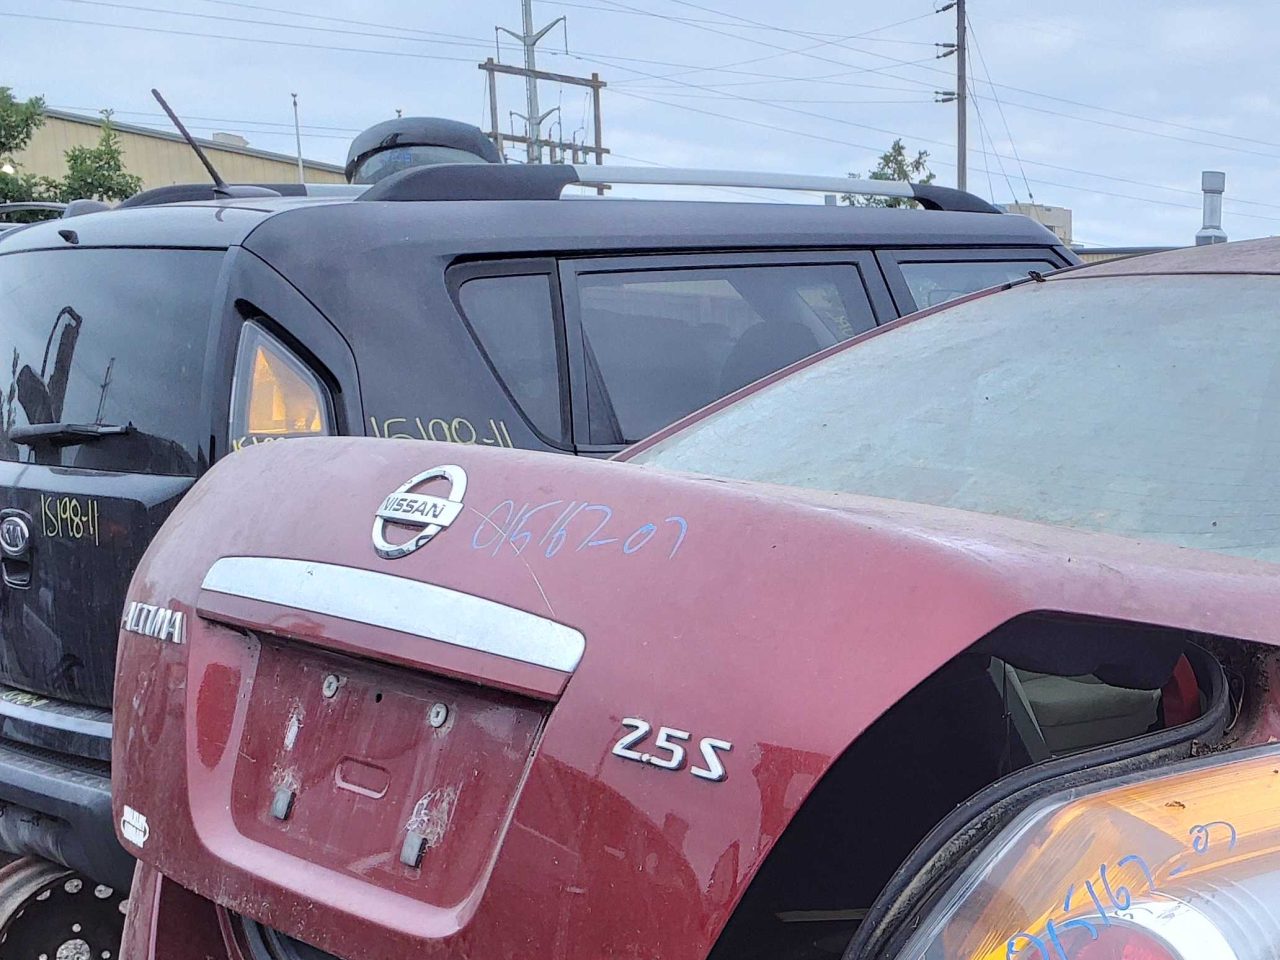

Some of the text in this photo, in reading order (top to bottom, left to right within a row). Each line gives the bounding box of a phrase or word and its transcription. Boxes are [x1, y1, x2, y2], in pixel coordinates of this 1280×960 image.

[383, 496, 446, 519] NISSAN
[121, 601, 184, 644] ALTIMA
[690, 737, 733, 781] S
